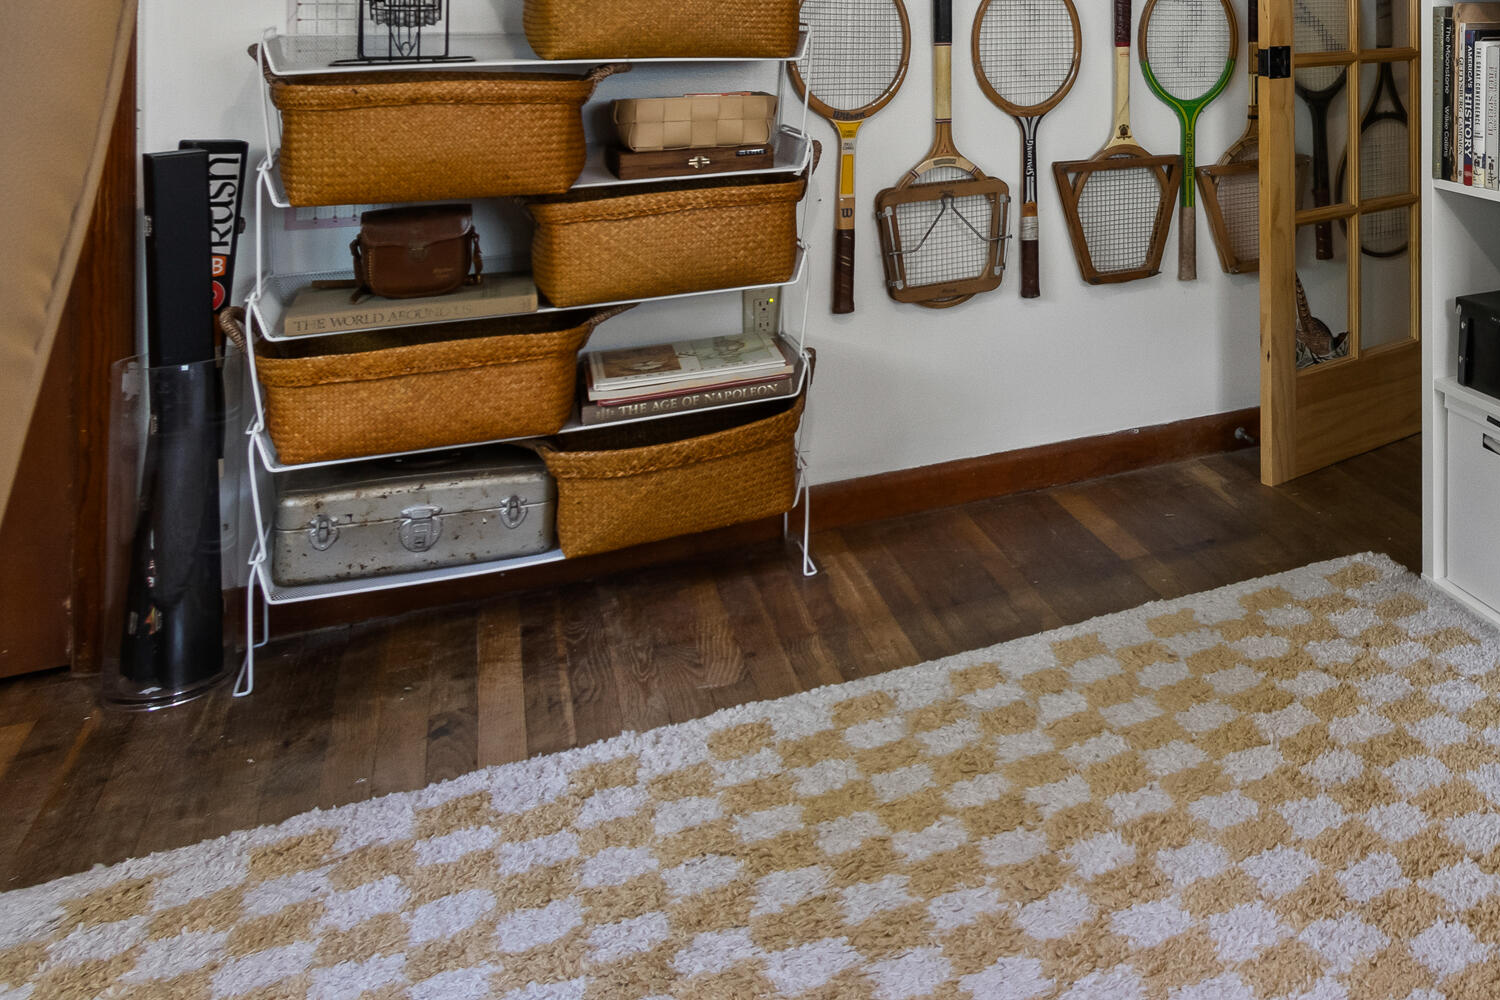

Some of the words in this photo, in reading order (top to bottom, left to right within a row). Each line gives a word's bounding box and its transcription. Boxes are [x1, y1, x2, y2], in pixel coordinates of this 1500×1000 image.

[294, 319, 325, 331] THE
[329, 313, 385, 328] WORLD
[618, 403, 647, 417] THE
[652, 399, 677, 411] AGE
[681, 395, 699, 407] OF
[704, 384, 778, 403] NAPOLEON
